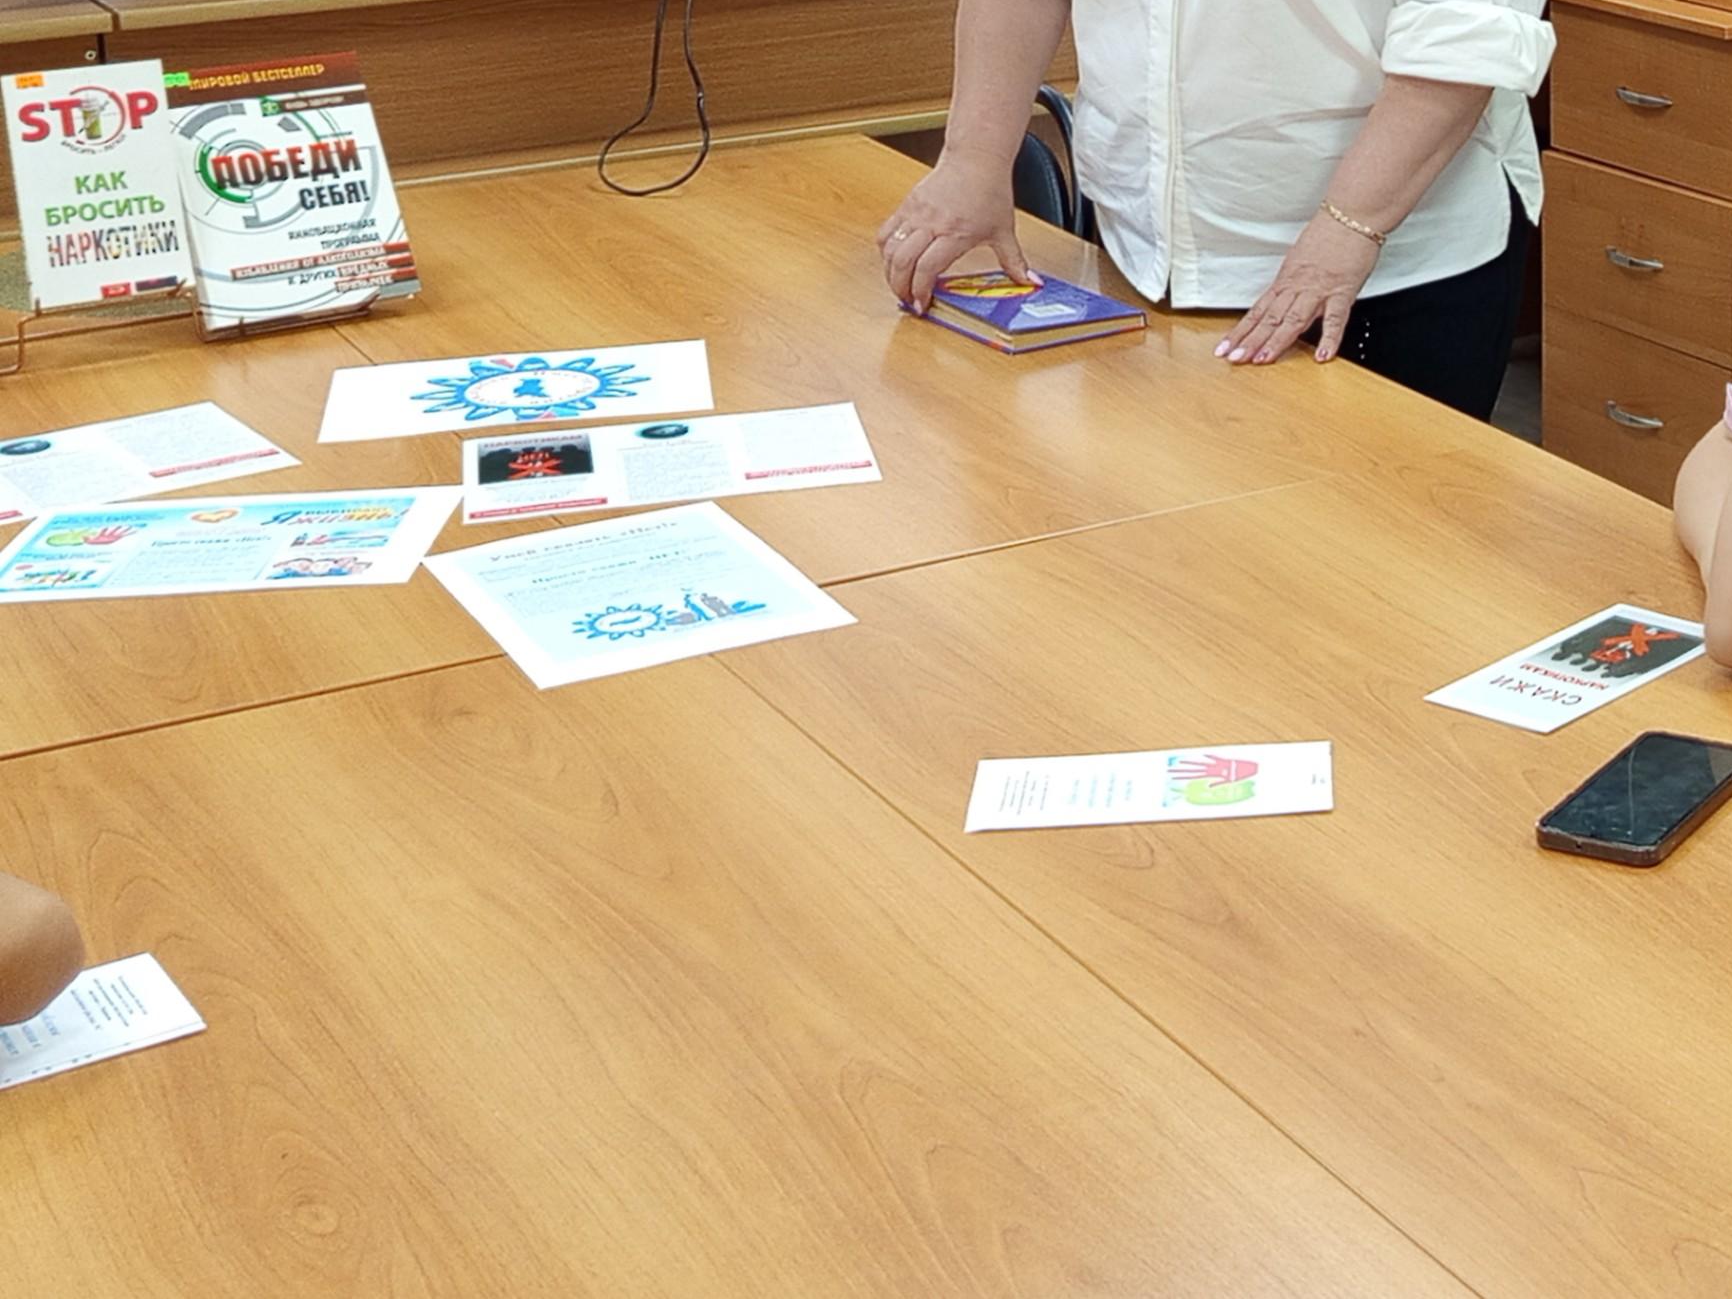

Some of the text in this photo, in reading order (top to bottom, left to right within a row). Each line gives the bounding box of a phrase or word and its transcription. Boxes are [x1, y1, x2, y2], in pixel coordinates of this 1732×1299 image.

[252, 63, 325, 82] БЕСТСЕЛЛЕР
[17, 86, 159, 143] STOP
[210, 138, 363, 191] ПОБЕДИ
[74, 171, 129, 195] КАК
[298, 179, 371, 211] СЕБЯ!
[43, 195, 166, 227] БРОСИТЬ
[46, 220, 180, 268] НАРКОТИКИ
[1489, 673, 1584, 707] СКАЖИ
[1519, 660, 1611, 690] НАРКОТИКАМ
